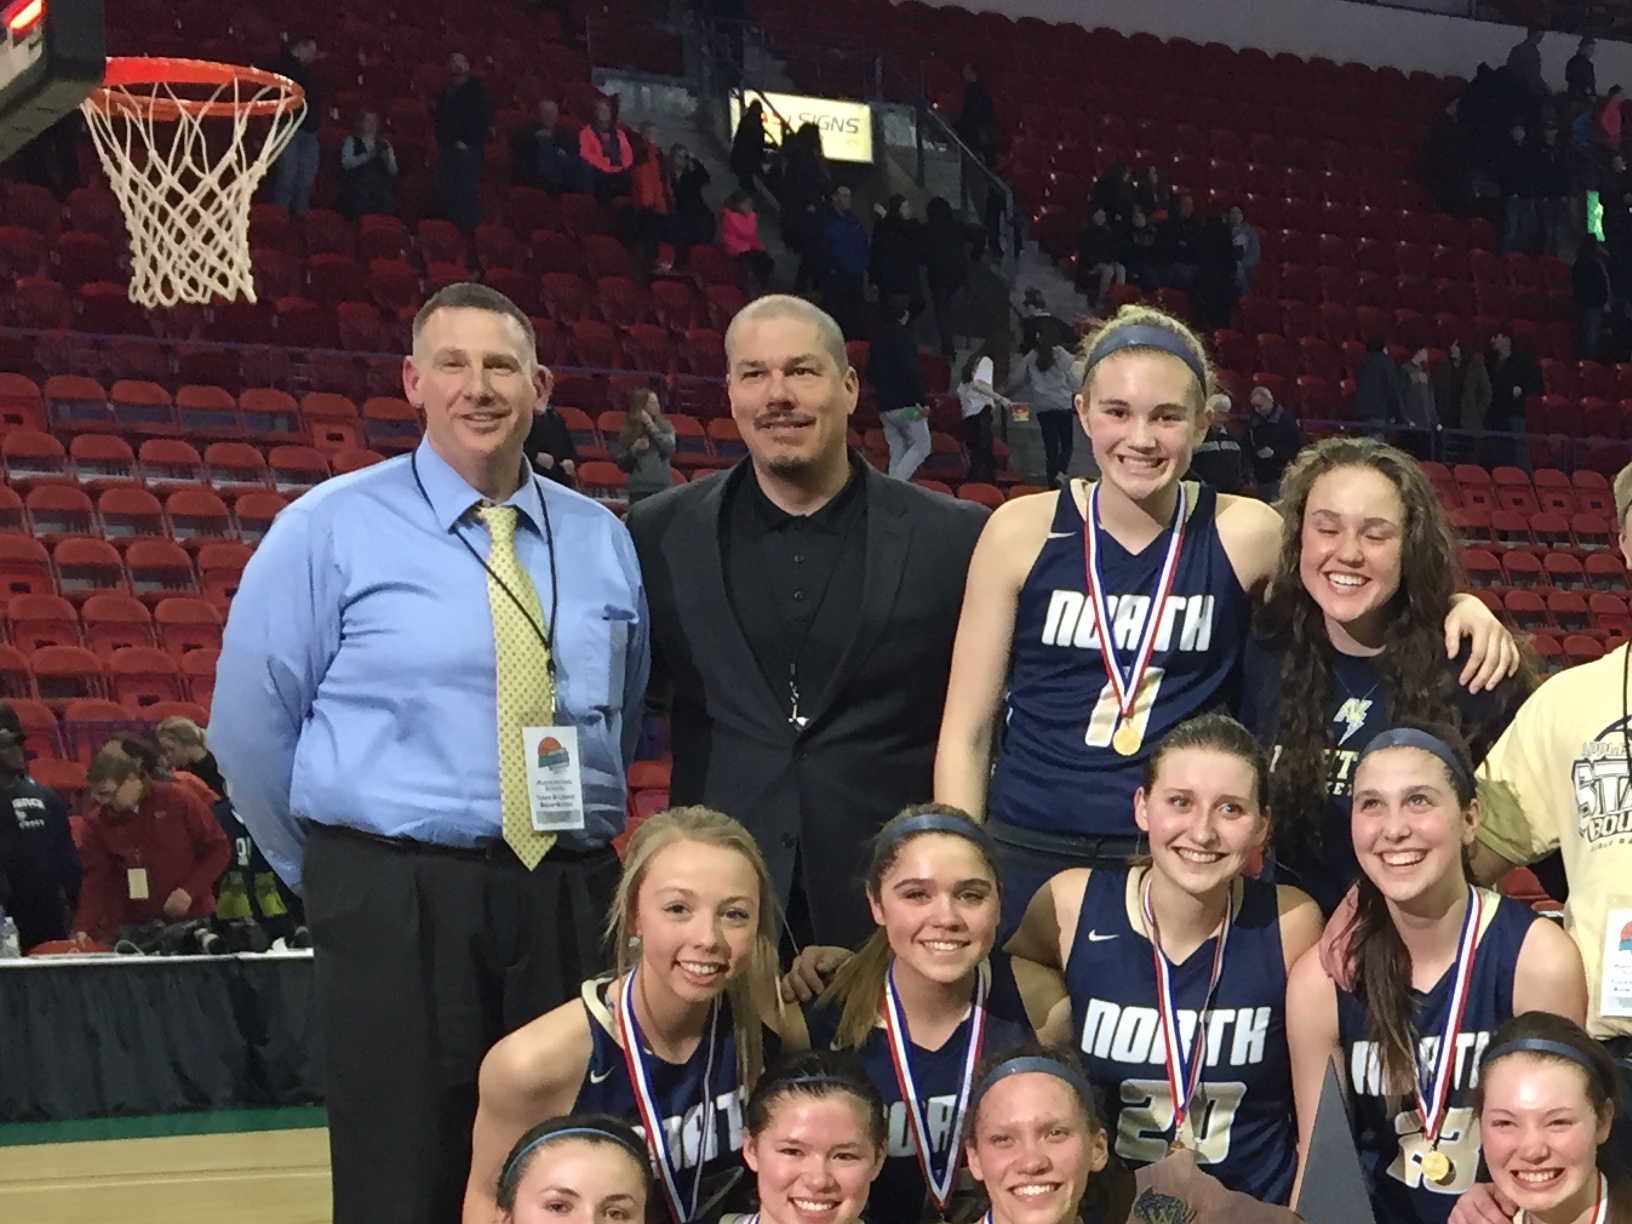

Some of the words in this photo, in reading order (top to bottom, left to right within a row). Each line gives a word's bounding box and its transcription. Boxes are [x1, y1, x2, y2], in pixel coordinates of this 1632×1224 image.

[1081, 997, 1272, 1067] NORTH
[1351, 1030, 1490, 1097] NRT
[1114, 1078, 1248, 1165] 20
